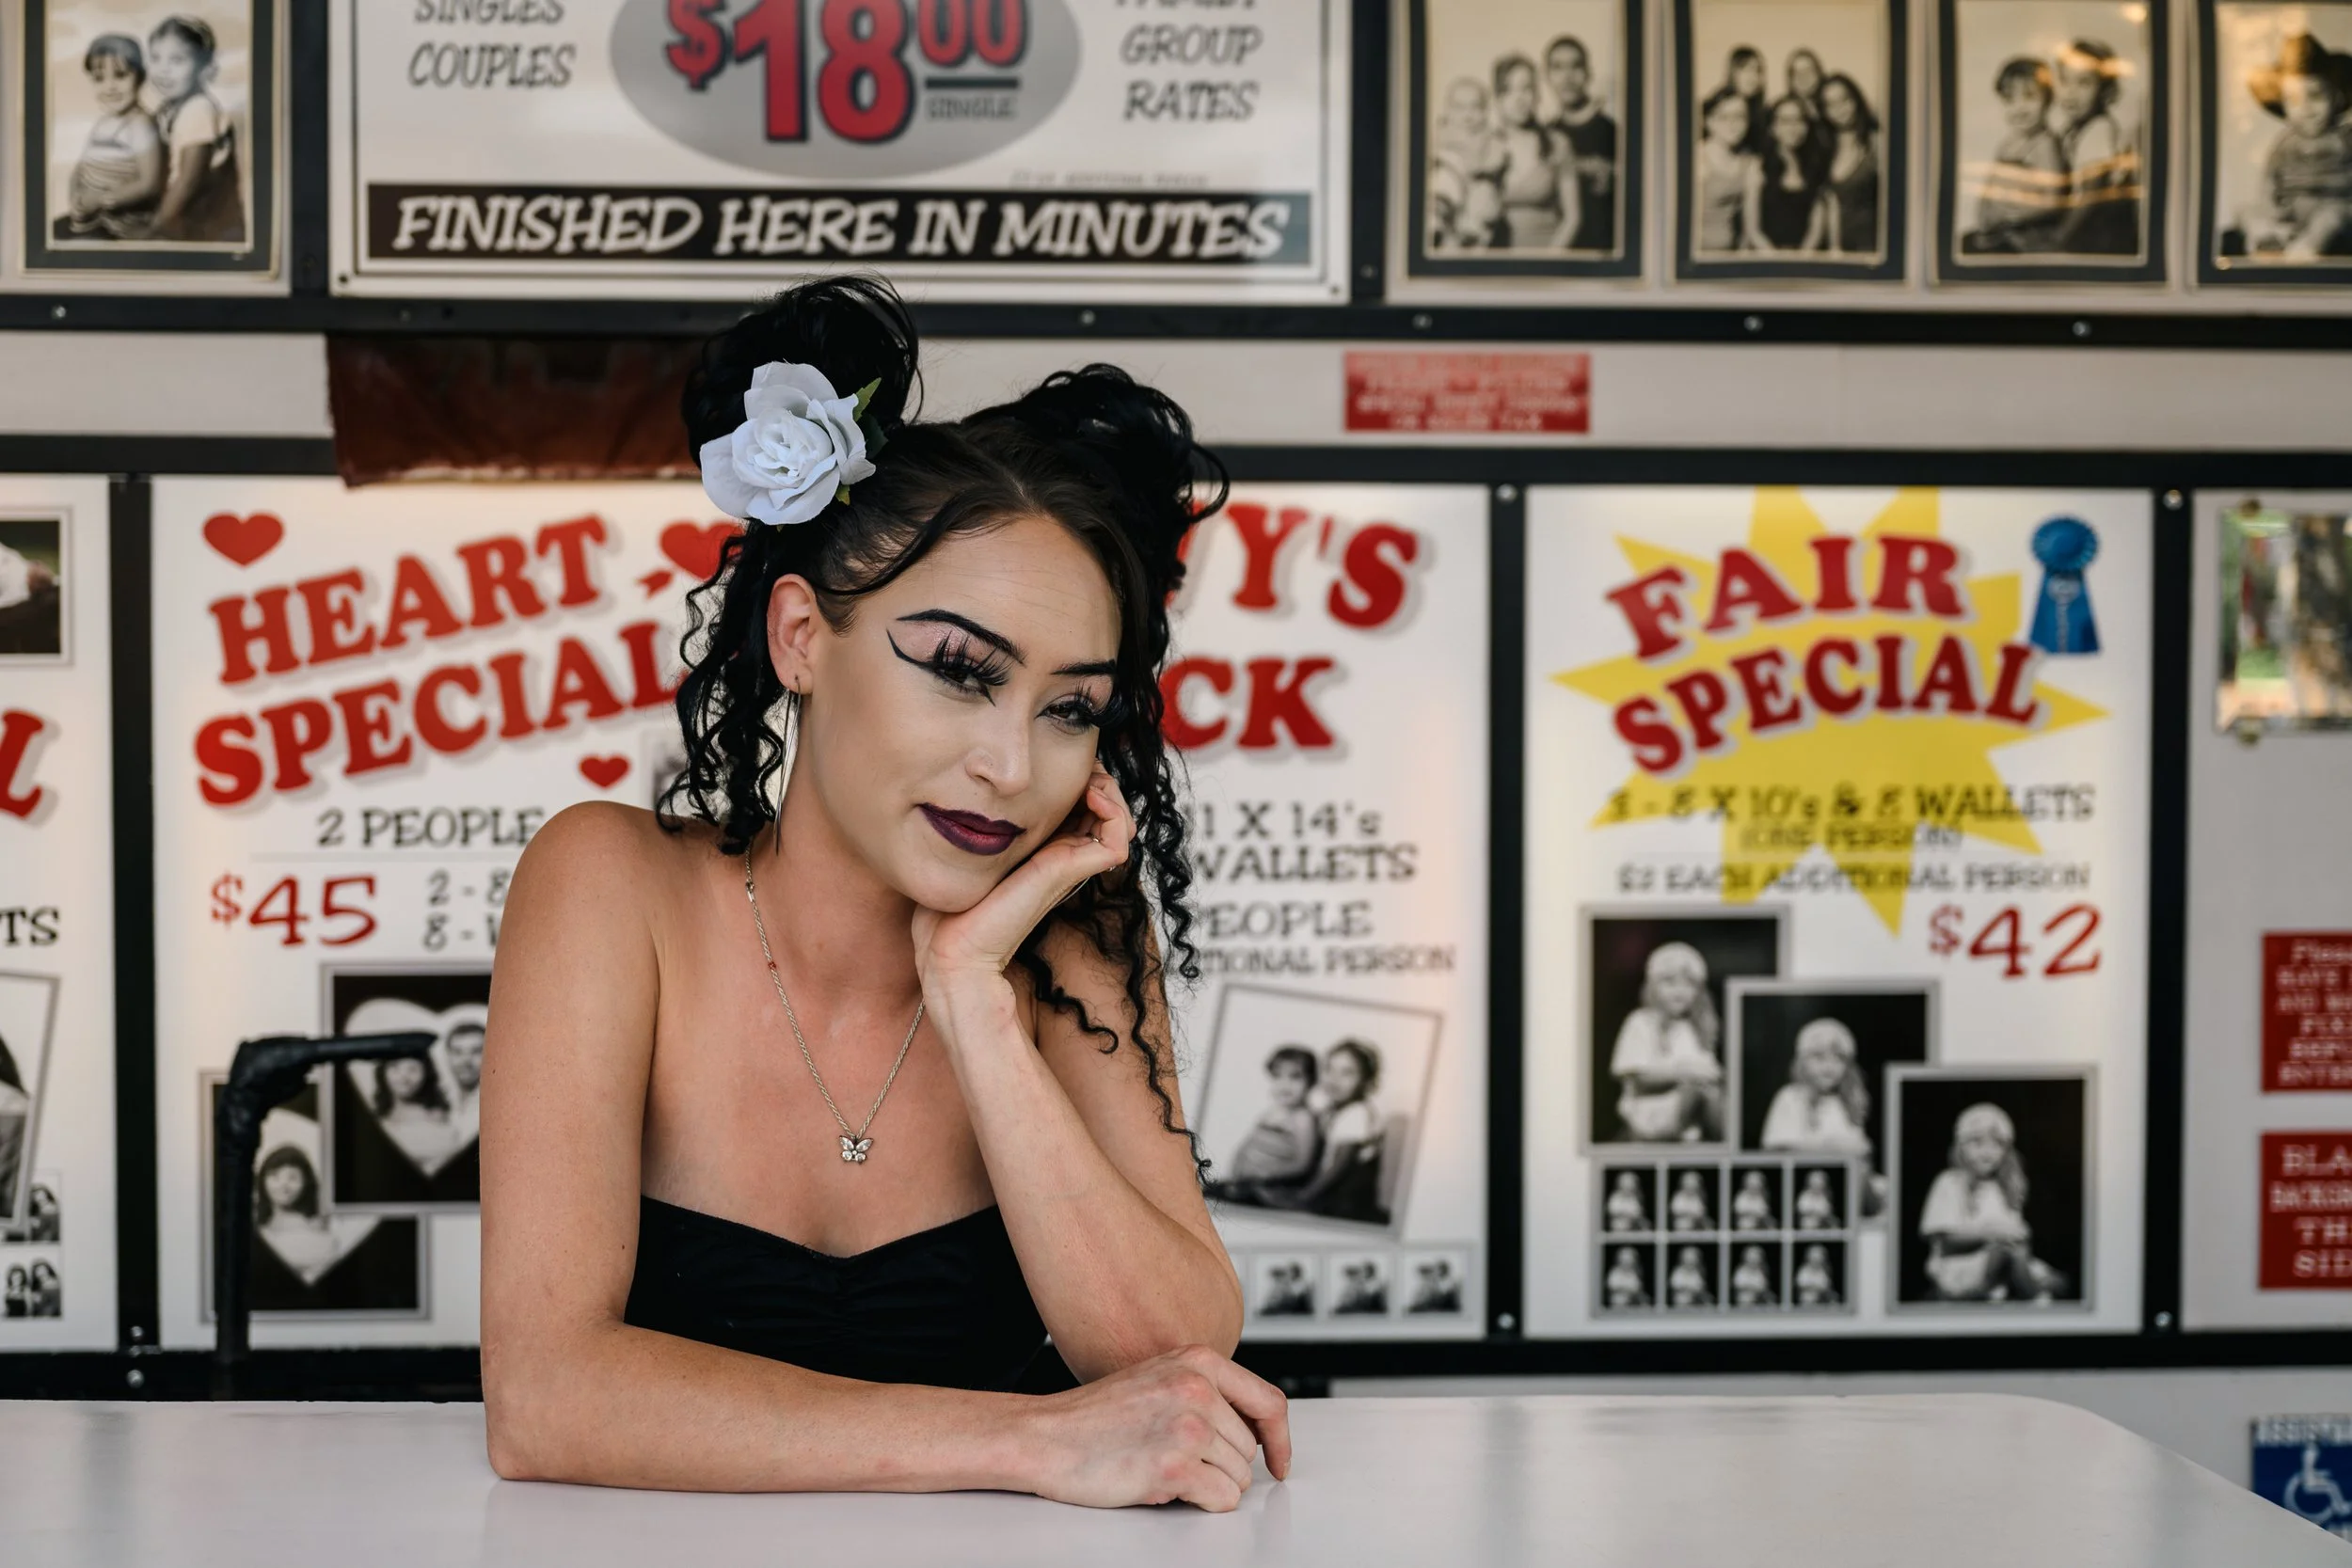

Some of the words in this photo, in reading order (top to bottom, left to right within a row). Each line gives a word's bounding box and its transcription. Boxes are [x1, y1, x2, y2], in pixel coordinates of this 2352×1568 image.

[407, 41, 577, 88] COUPLES
[1120, 24, 1264, 66] GROUP
[1123, 79, 1261, 122] RATES
[392, 195, 703, 254] FINISHED
[713, 197, 898, 257] HERE
[908, 199, 987, 256] IN
[993, 199, 1290, 259] MINUTES
[208, 514, 608, 686] HEART
[1604, 533, 1963, 659] FAIR
[194, 620, 690, 807] SPECIAL
[1613, 632, 2040, 776] SPECIAL
[1235, 800, 1271, 839] X
[1291, 800, 1382, 837] 14's
[1707, 786, 1738, 824] X
[1831, 781, 1862, 821] &
[1914, 784, 2096, 822] WALLETS
[317, 808, 344, 847] 2
[361, 808, 545, 847] PEOPLE
[428, 868, 450, 908] 2
[1964, 863, 2090, 893] PERSON
[210, 870, 379, 948] $45
[1200, 899, 1374, 938] EOPLE
[422, 911, 450, 954] 8
[1928, 903, 2102, 980] $42
[1326, 945, 1455, 974] PERSON
